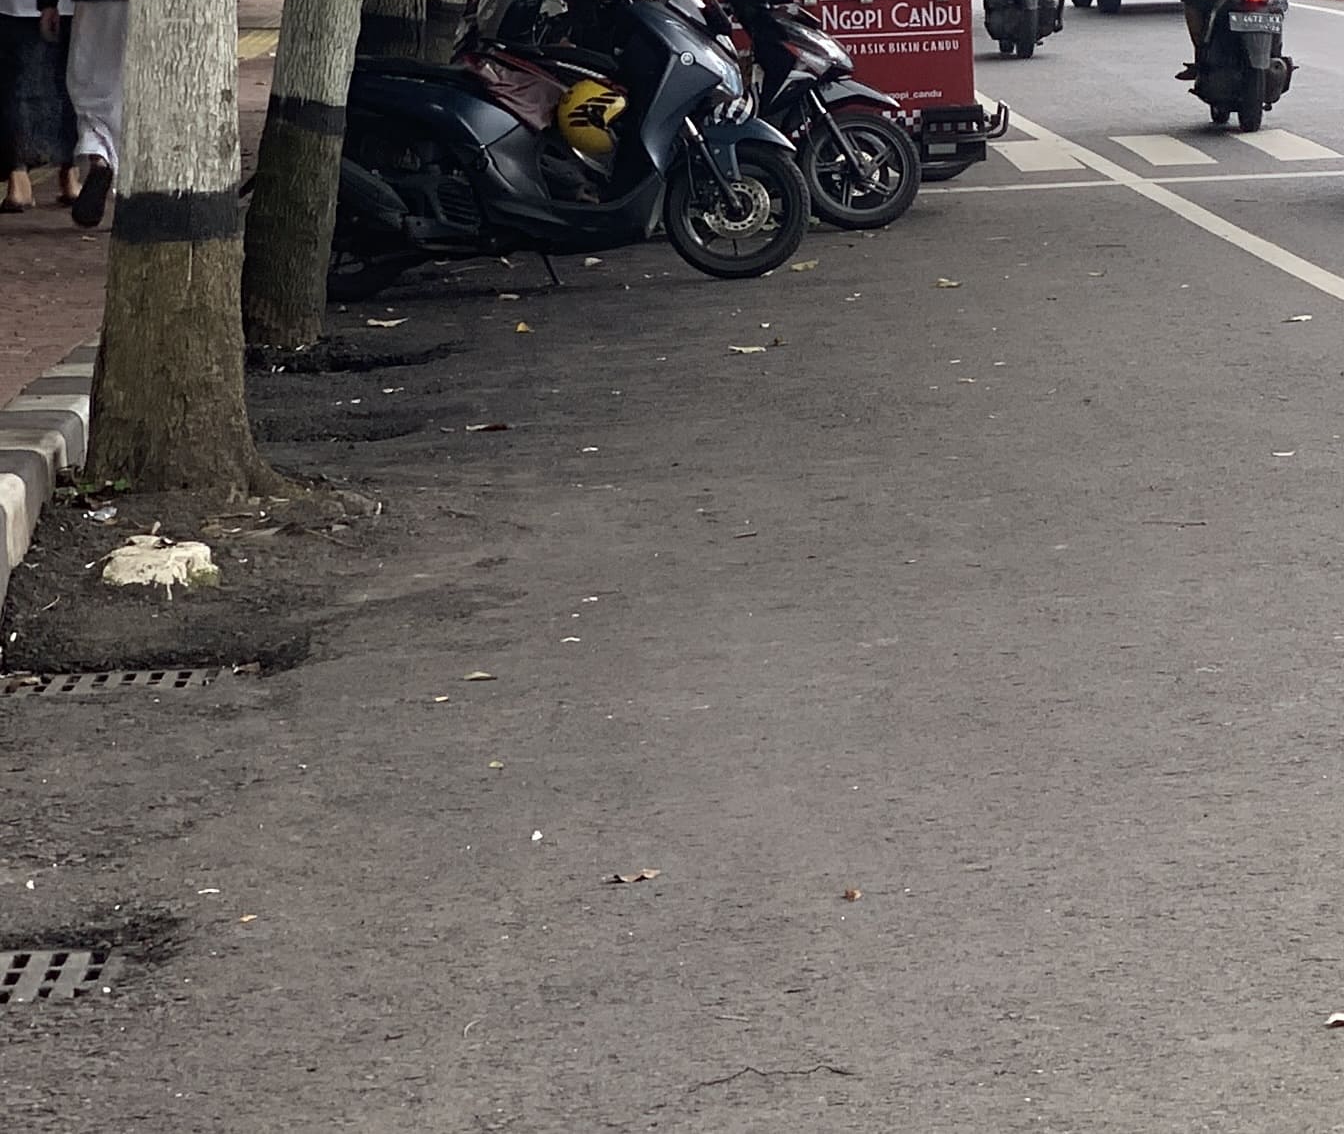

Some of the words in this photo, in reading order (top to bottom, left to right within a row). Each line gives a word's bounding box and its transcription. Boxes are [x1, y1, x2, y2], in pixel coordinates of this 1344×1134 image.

[860, 43, 885, 55] ASIK
[888, 41, 920, 53] BIKIN
[922, 39, 960, 52] CANDU
